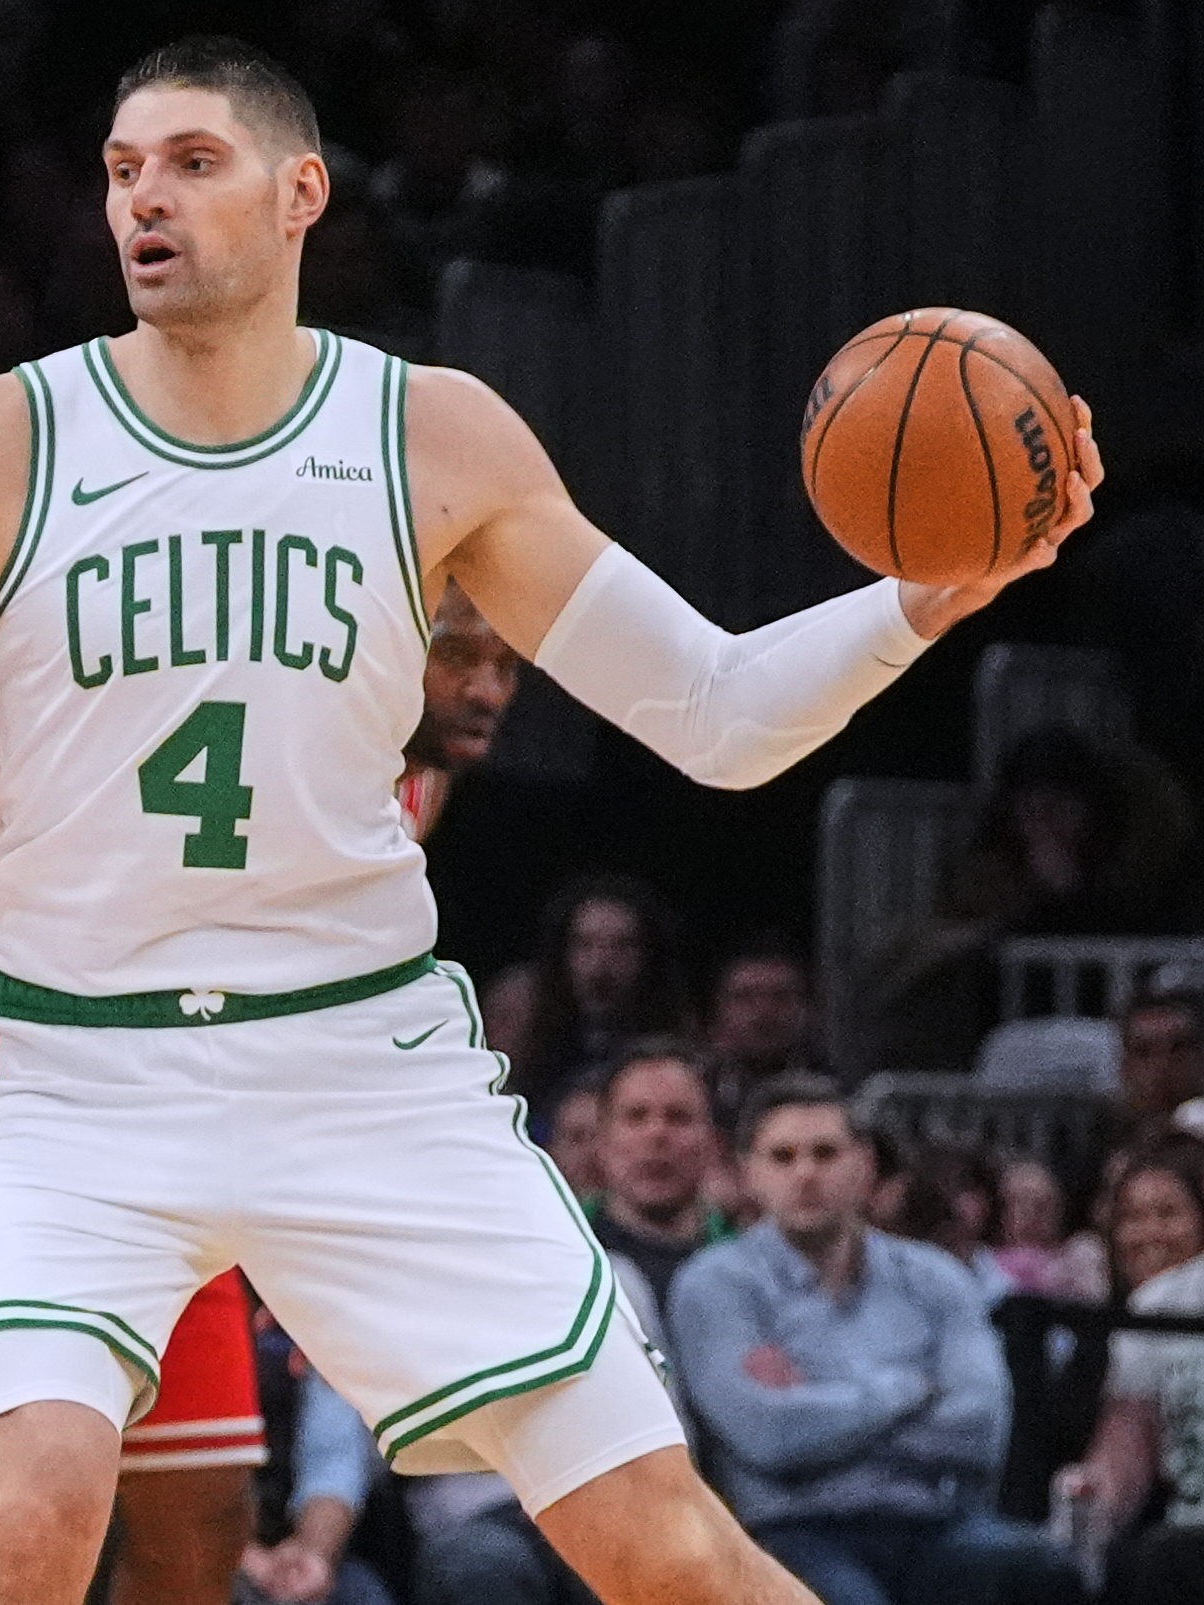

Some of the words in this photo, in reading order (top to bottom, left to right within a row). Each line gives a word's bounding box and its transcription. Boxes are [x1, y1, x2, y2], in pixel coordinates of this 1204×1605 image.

[295, 455, 373, 481] Amica
[66, 529, 363, 689] CELTICS
[137, 700, 253, 870] 4
